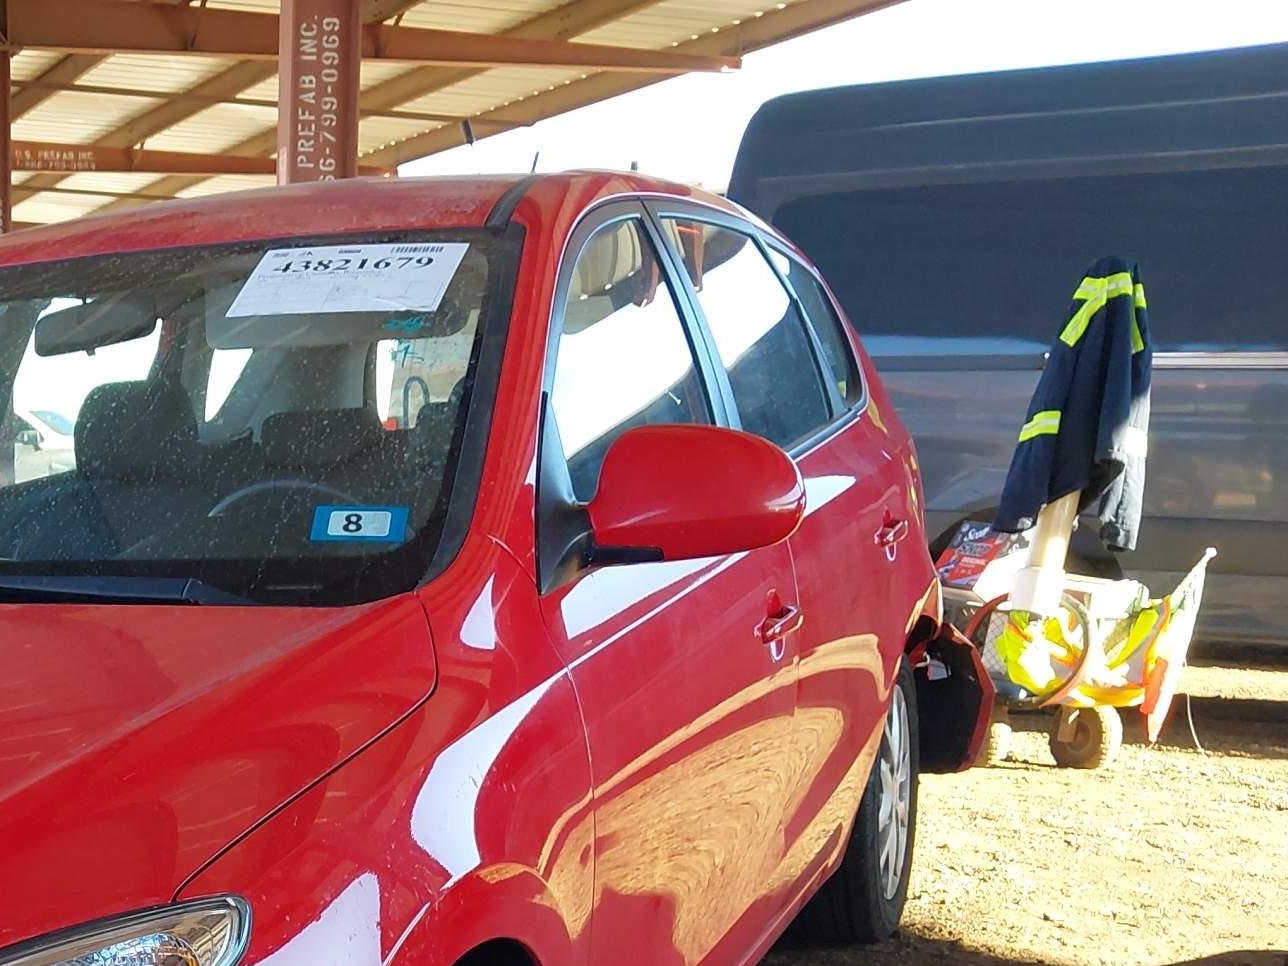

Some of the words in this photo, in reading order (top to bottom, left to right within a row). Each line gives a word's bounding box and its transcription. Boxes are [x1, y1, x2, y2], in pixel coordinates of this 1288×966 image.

[299, 14, 318, 61] INC.
[297, 74, 317, 169] PREFAB
[273, 255, 435, 274] 43821679
[342, 513, 363, 533] 8
